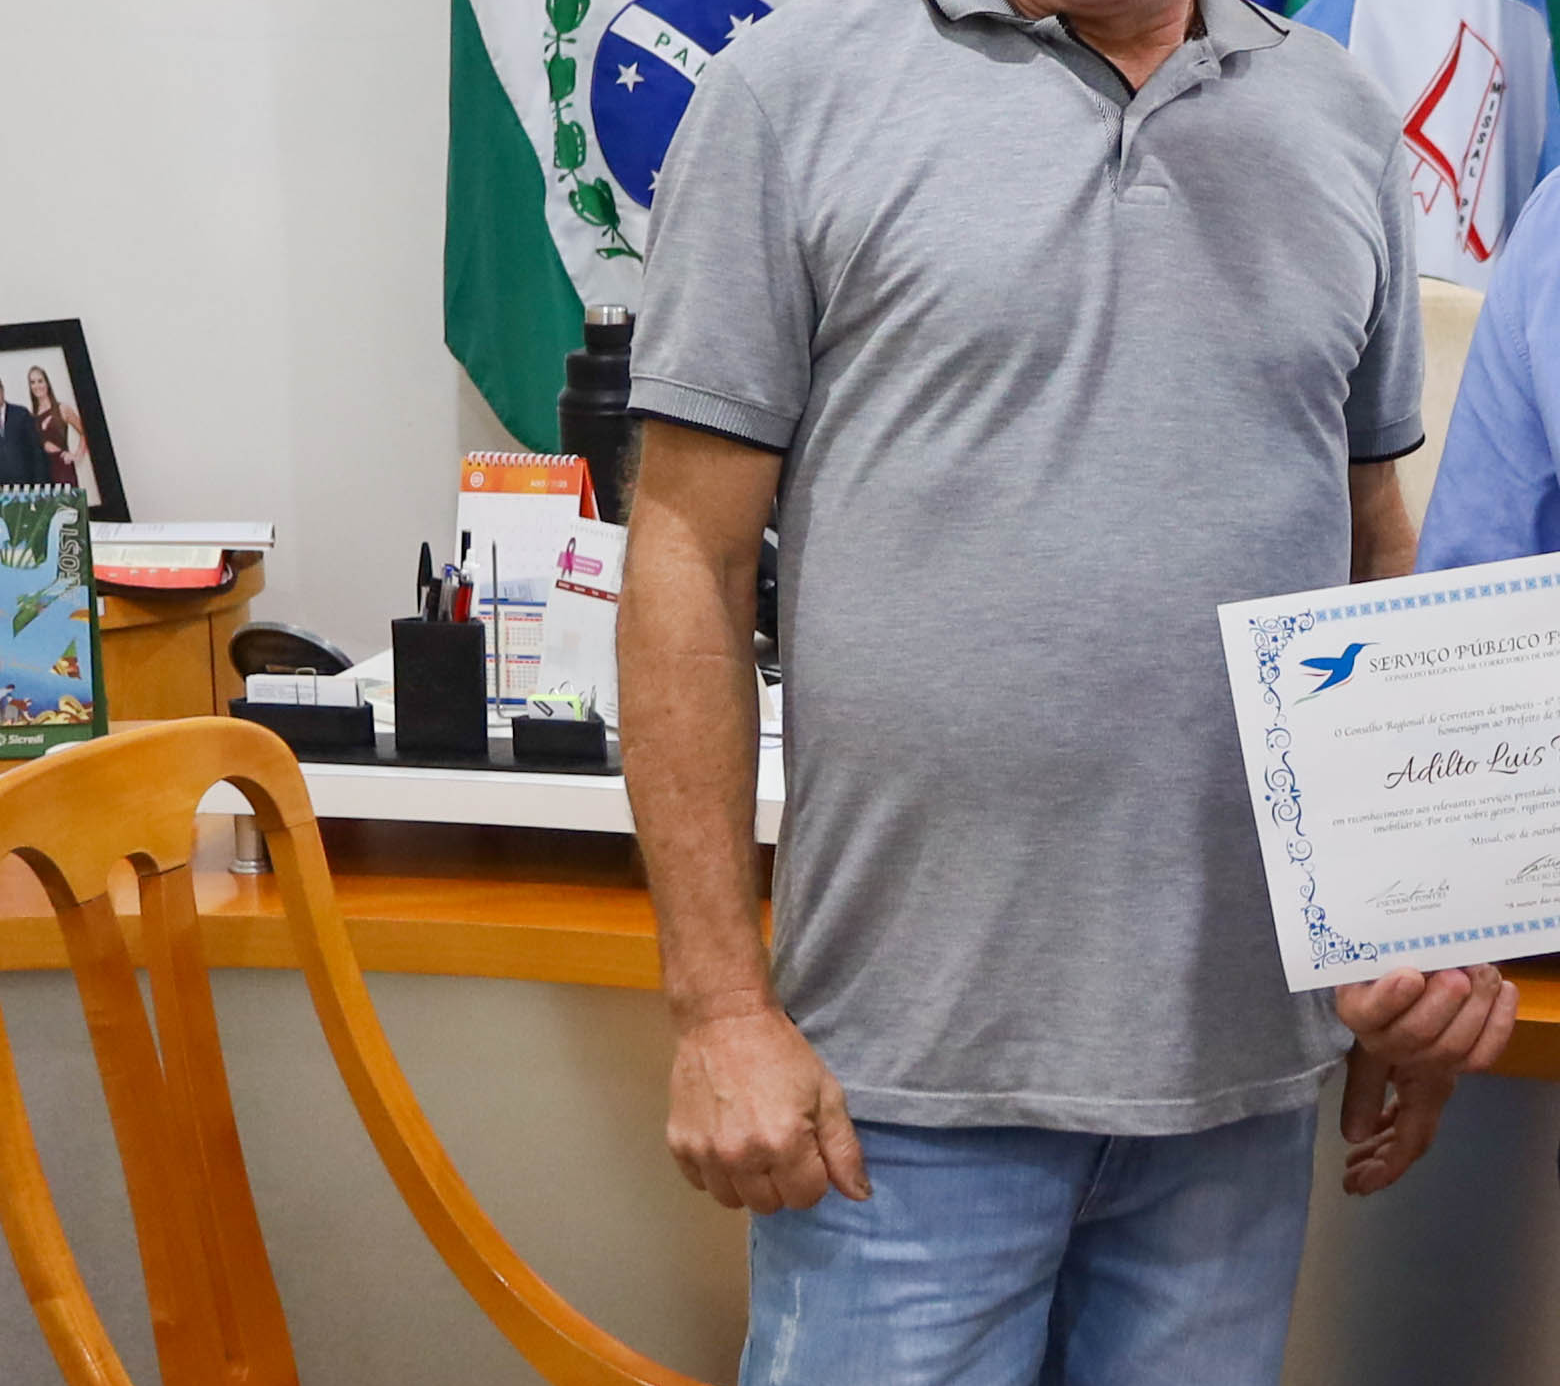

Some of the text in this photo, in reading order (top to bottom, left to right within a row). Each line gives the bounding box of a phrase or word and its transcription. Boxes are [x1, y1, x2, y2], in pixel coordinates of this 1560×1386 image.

[1469, 82, 1503, 178] MISSAL
[1369, 647, 1449, 672] SERVIÇO
[1454, 633, 1540, 659] PÚBLICO
[8, 733, 45, 745] Sicredi
[1343, 722, 1383, 737] Conselho
[1384, 715, 1425, 733] Regional
[1384, 749, 1479, 789] Adilto
[1486, 742, 1545, 774] Luis
